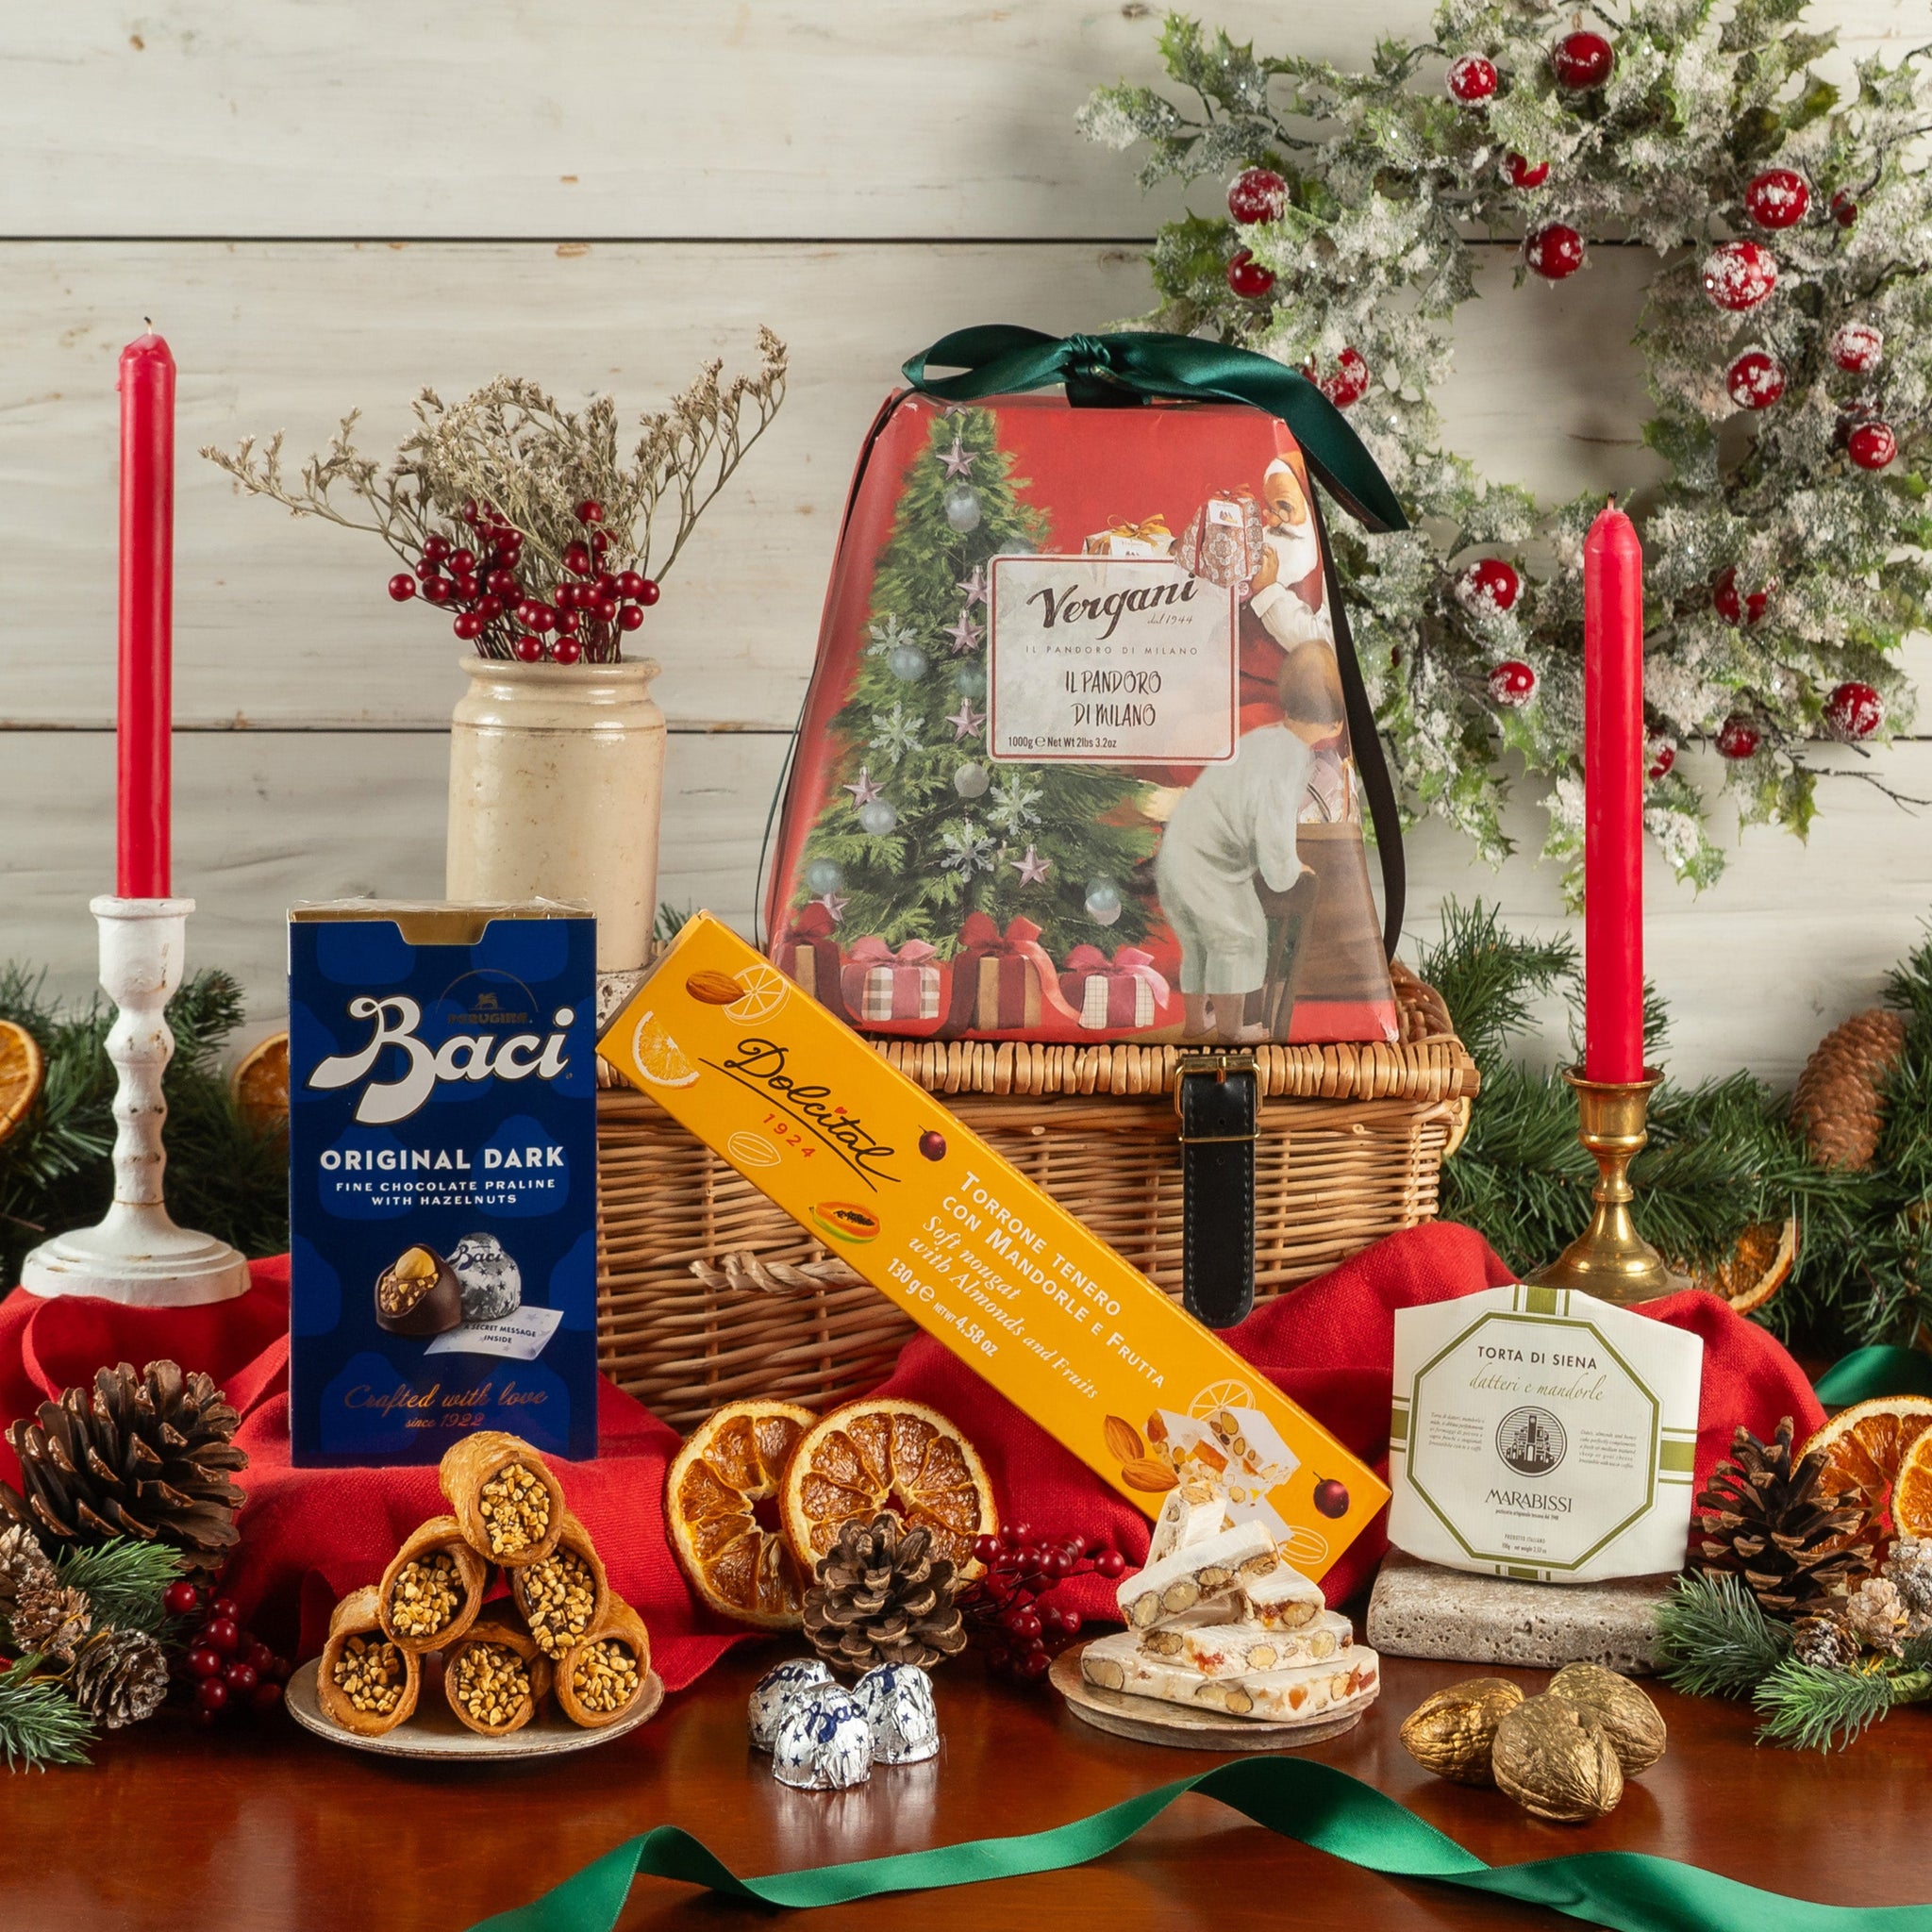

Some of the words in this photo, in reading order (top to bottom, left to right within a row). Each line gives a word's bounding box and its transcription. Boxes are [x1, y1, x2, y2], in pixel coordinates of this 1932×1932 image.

[1026, 573, 1198, 640] Vergani
[1165, 615, 1193, 625] 1944
[1025, 645, 1037, 654] IL
[1046, 645, 1112, 655] PANDORO
[1123, 646, 1134, 655] DI
[1144, 646, 1198, 656] MILANO
[1065, 671, 1078, 693] IL
[1081, 671, 1161, 695] PANDORO
[1071, 703, 1090, 726] DI
[1096, 703, 1156, 726] MILANO
[1047, 737, 1062, 747] Net
[1063, 737, 1075, 748] Wt
[1076, 737, 1093, 748] 2lbs
[1095, 737, 1117, 748] 3.2oz
[307, 995, 575, 1125] Baci
[723, 1038, 902, 1182] Dolcital
[761, 1113, 816, 1158] 1924
[320, 1148, 471, 1171] ORIGINAL
[484, 1146, 564, 1169] DARK
[336, 1182, 373, 1191] FINE
[380, 1181, 477, 1191] CHOCOLATE
[485, 1179, 556, 1190] PRALINE
[372, 1196, 412, 1206] WITH
[421, 1194, 517, 1205] HAZELNUTS
[942, 1195, 982, 1232] CON
[448, 1244, 502, 1271] Baci
[923, 1215, 961, 1248] Soft
[959, 1248, 1022, 1302] nougat
[1052, 1253, 1122, 1316] TENERO
[908, 1235, 951, 1274] with
[949, 1273, 1025, 1337] Almonds
[1022, 1336, 1058, 1362] and
[1052, 1357, 1099, 1400] Fruits
[955, 1315, 985, 1344] 4.58
[471, 1323, 498, 1332] SECRET
[499, 1326, 537, 1338] MESSAGE
[483, 1335, 512, 1343] INSIDE
[1477, 1346, 1524, 1362] TORTA
[1531, 1352, 1545, 1364] DI
[1553, 1354, 1597, 1370] SIENA
[1469, 1362, 1519, 1393] datteri
[1524, 1383, 1532, 1392] e
[1537, 1373, 1607, 1401] mandorle
[344, 1383, 441, 1418] Crafted
[441, 1382, 492, 1407] with
[498, 1380, 549, 1406] love
[405, 1416, 437, 1428] since
[441, 1412, 485, 1427] 1922
[1485, 1489, 1573, 1513] MARABISSI
